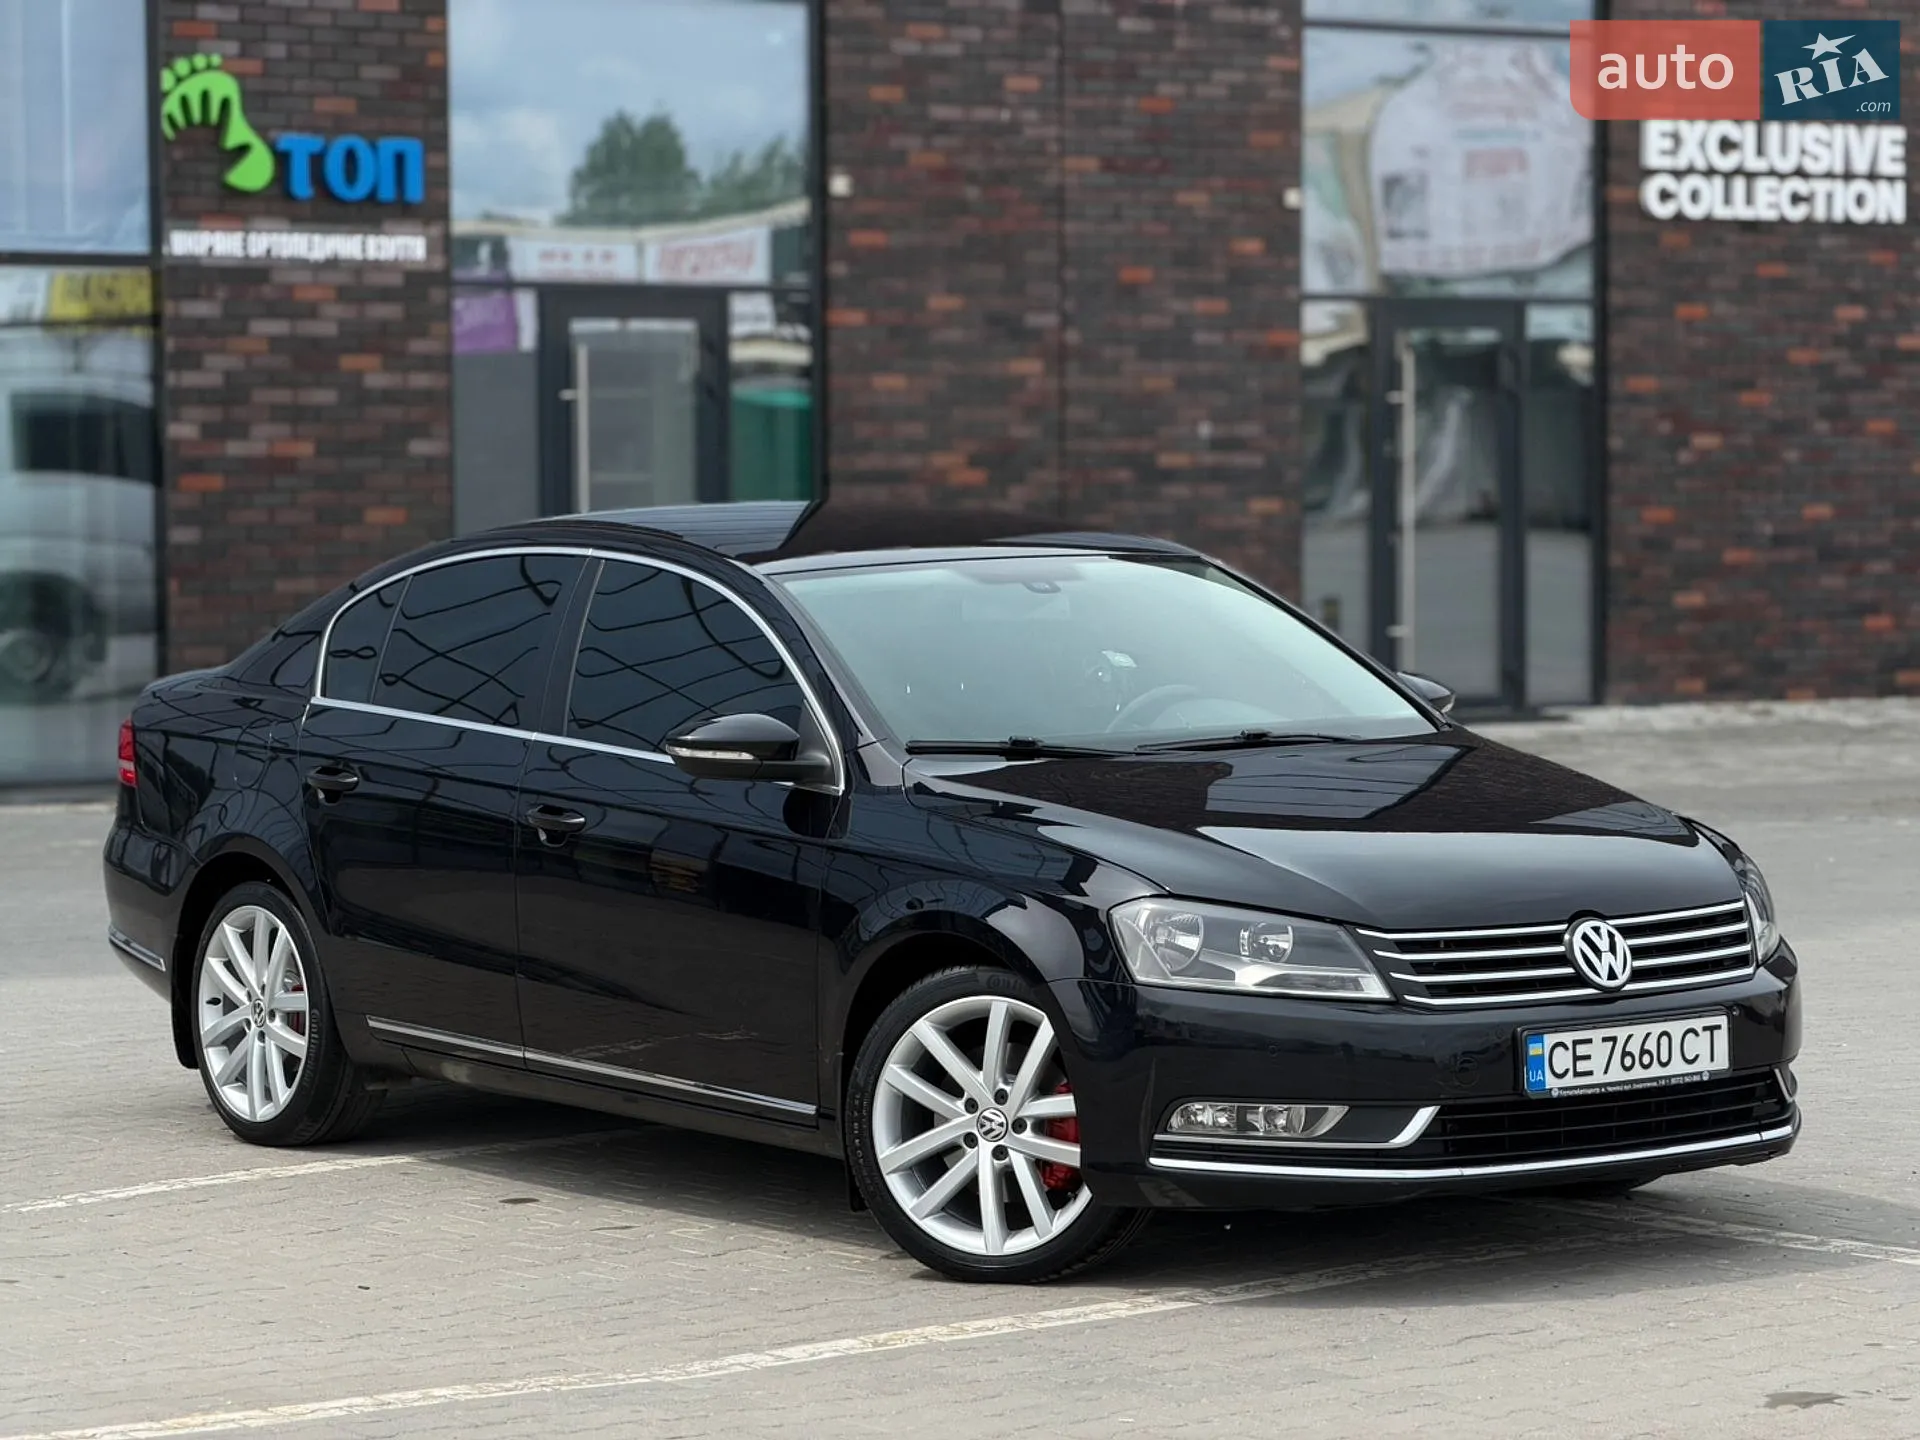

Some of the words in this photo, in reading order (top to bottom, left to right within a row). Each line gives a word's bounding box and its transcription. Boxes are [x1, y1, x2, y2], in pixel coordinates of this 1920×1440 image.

[1640, 120, 1906, 176] EXCLUSIVE
[1640, 173, 1906, 224] COLLECTION
[1529, 1069, 1544, 1082] UA
